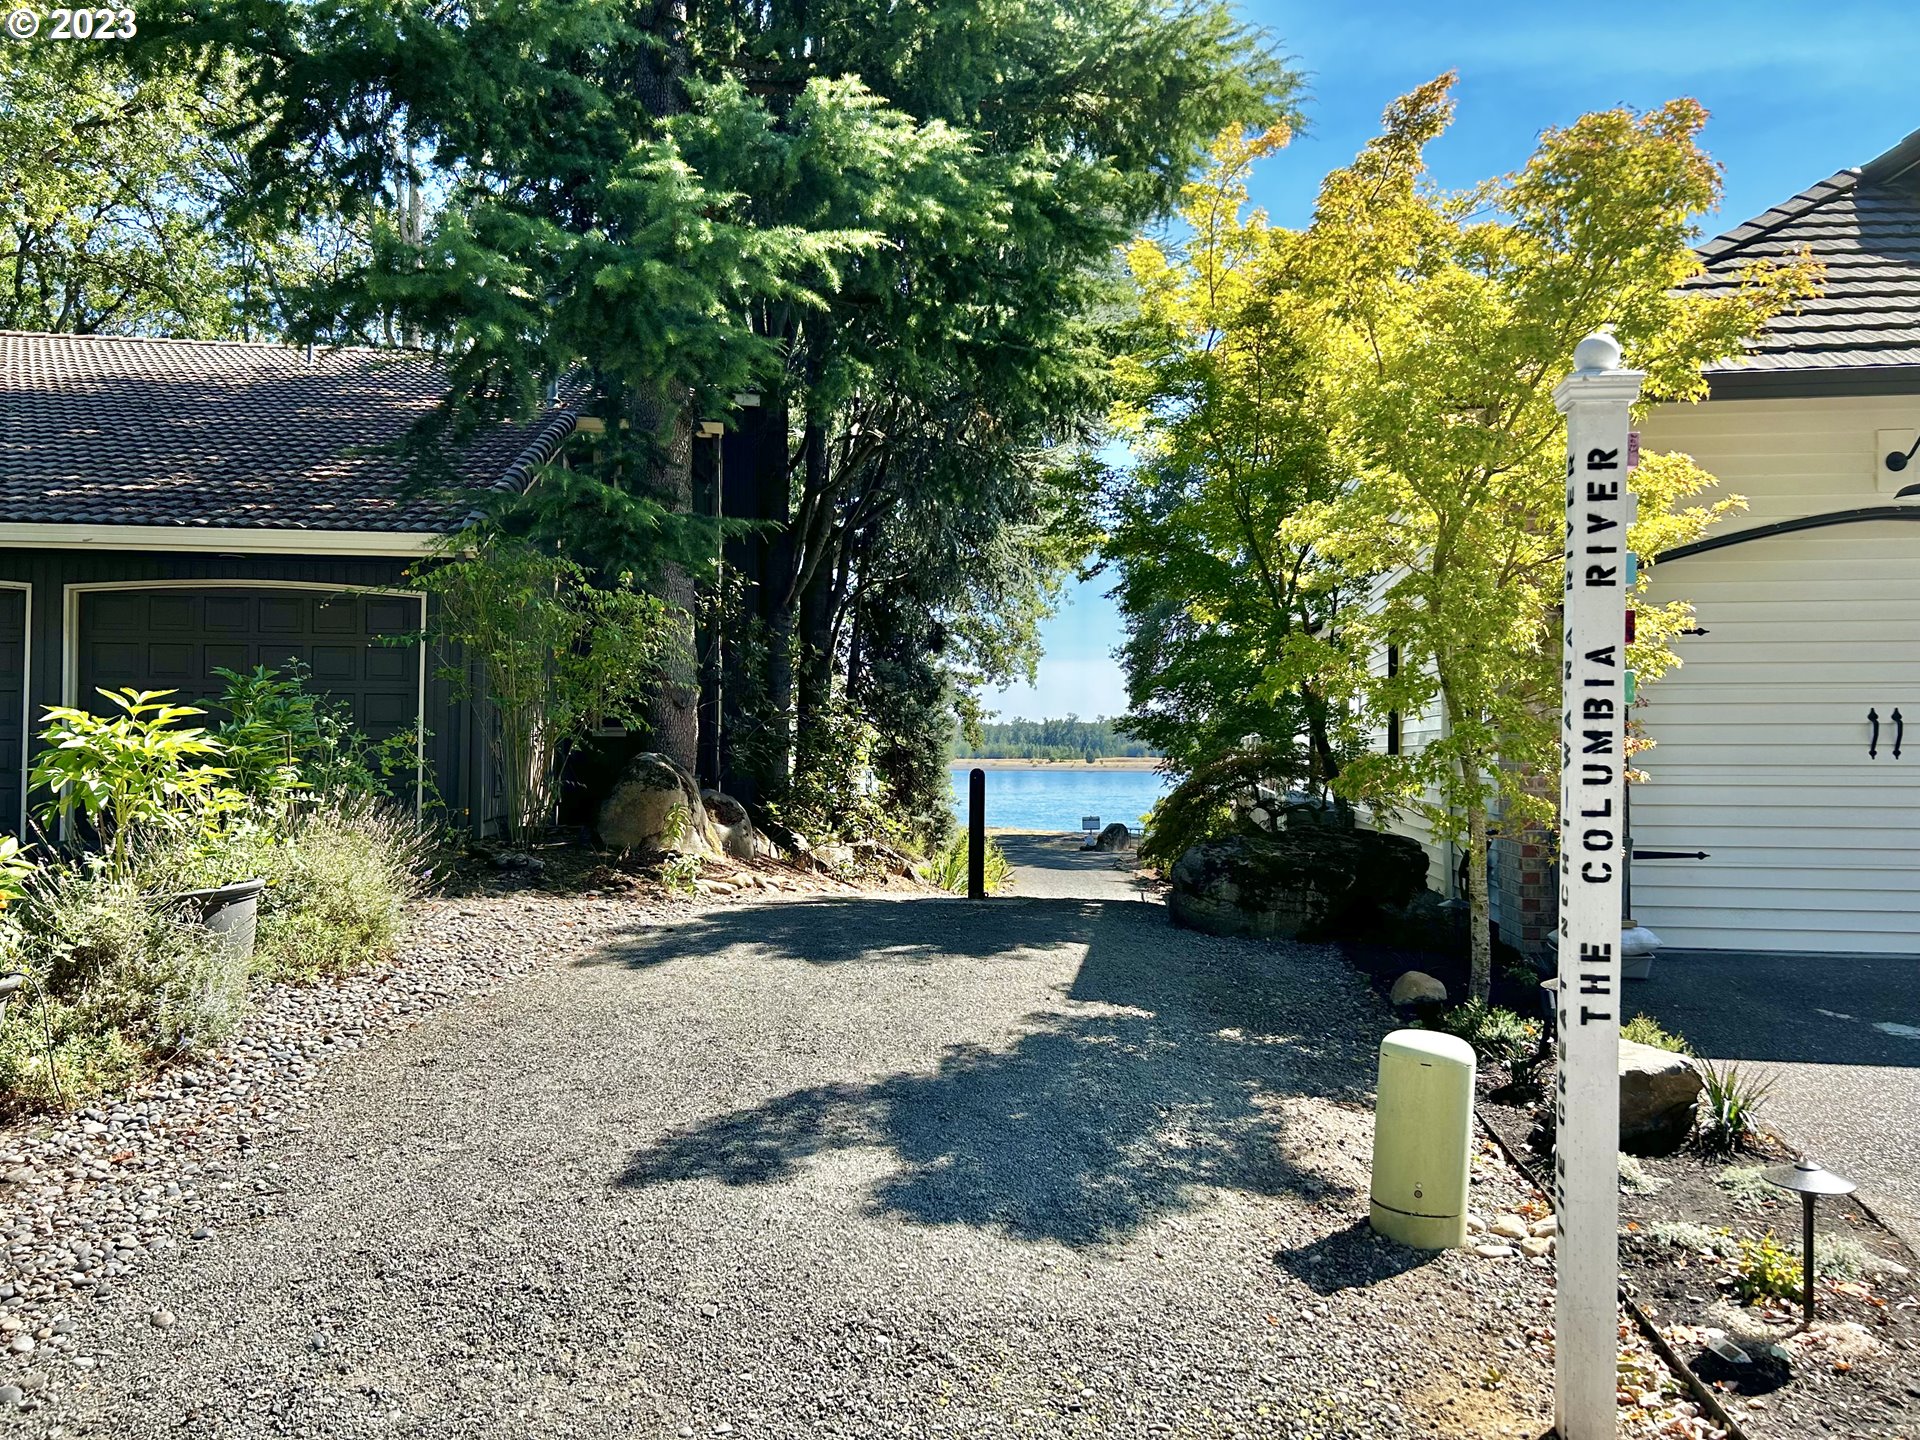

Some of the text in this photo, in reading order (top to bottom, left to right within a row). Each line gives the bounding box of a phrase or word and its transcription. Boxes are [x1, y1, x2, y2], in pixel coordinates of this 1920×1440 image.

[1566, 453, 1575, 590] RIVER
[1580, 448, 1618, 1026] THE COLUMBIA RIVER
[1558, 973, 1567, 1126] GREAT
[1557, 1152, 1565, 1238] THE
